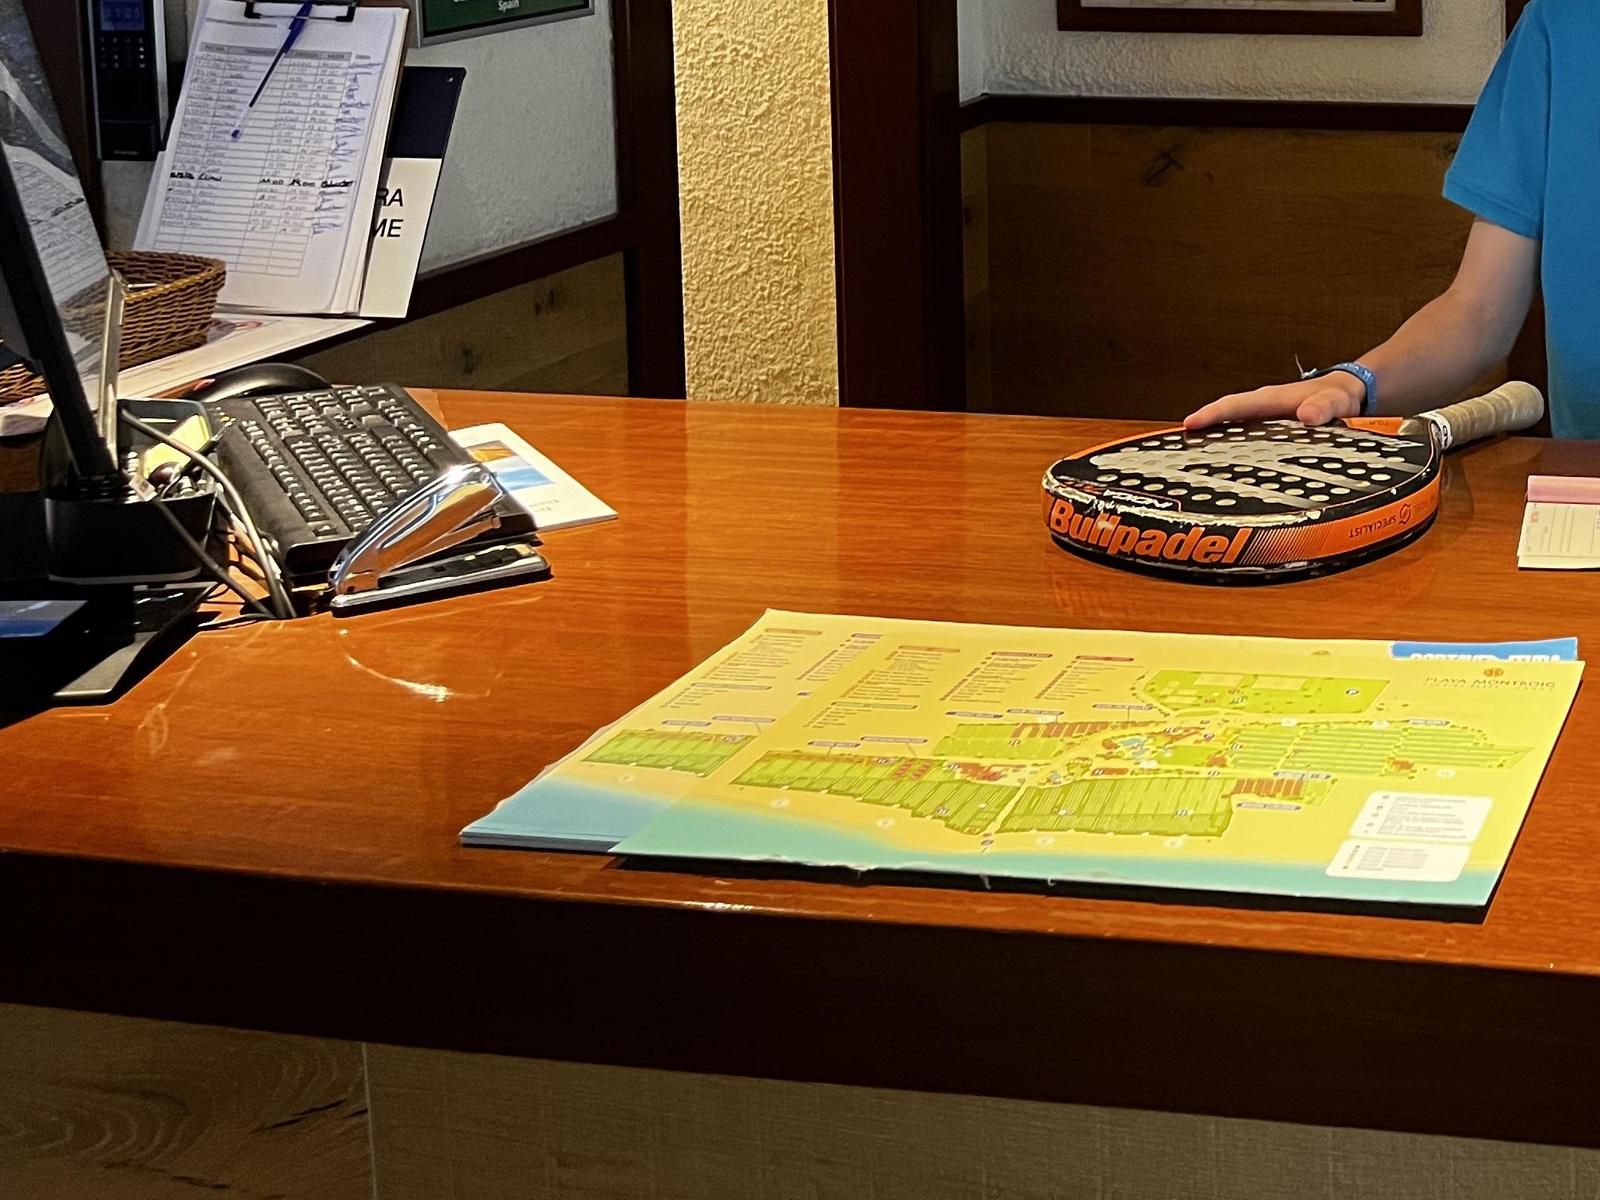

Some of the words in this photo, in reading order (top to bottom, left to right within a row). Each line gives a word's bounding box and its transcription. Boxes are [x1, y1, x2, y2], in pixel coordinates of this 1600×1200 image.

[498, 0, 520, 12] Spain
[1049, 498, 1254, 565] Bullpadel
[1348, 514, 1397, 539] SPECIALIST
